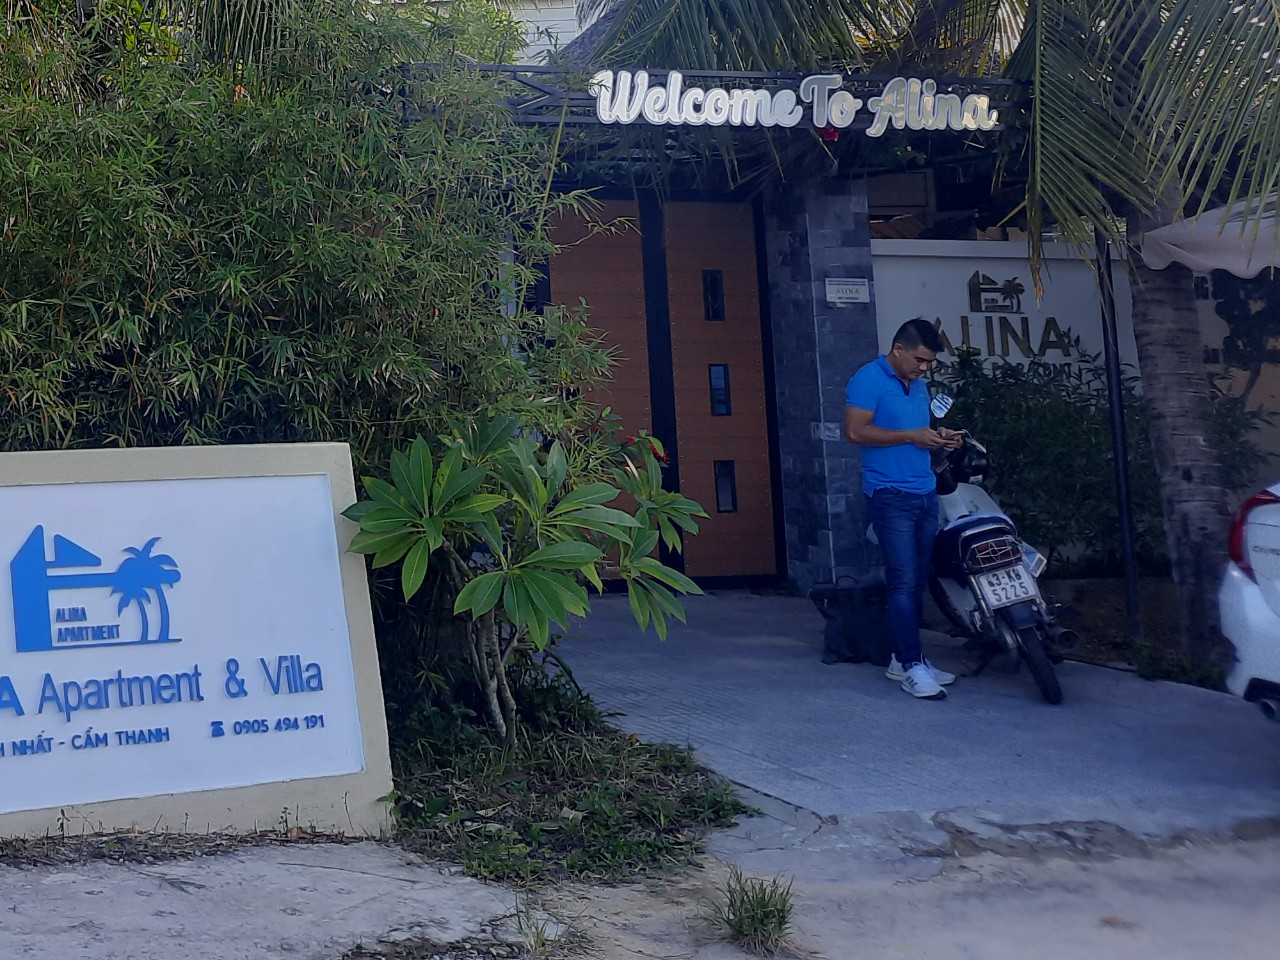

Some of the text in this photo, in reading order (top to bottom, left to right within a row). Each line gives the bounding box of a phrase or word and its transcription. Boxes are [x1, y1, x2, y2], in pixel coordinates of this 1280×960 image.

[588, 70, 998, 137] Welcome To Alina
[991, 581, 1030, 602] 5225
[55, 606, 88, 622] ALINA
[57, 624, 121, 642] APARTMENT
[37, 663, 205, 723] Apartment
[224, 658, 249, 698] &
[259, 654, 324, 695] Villa
[233, 714, 325, 735] 0905 494 191
[115, 727, 170, 746] THANH
